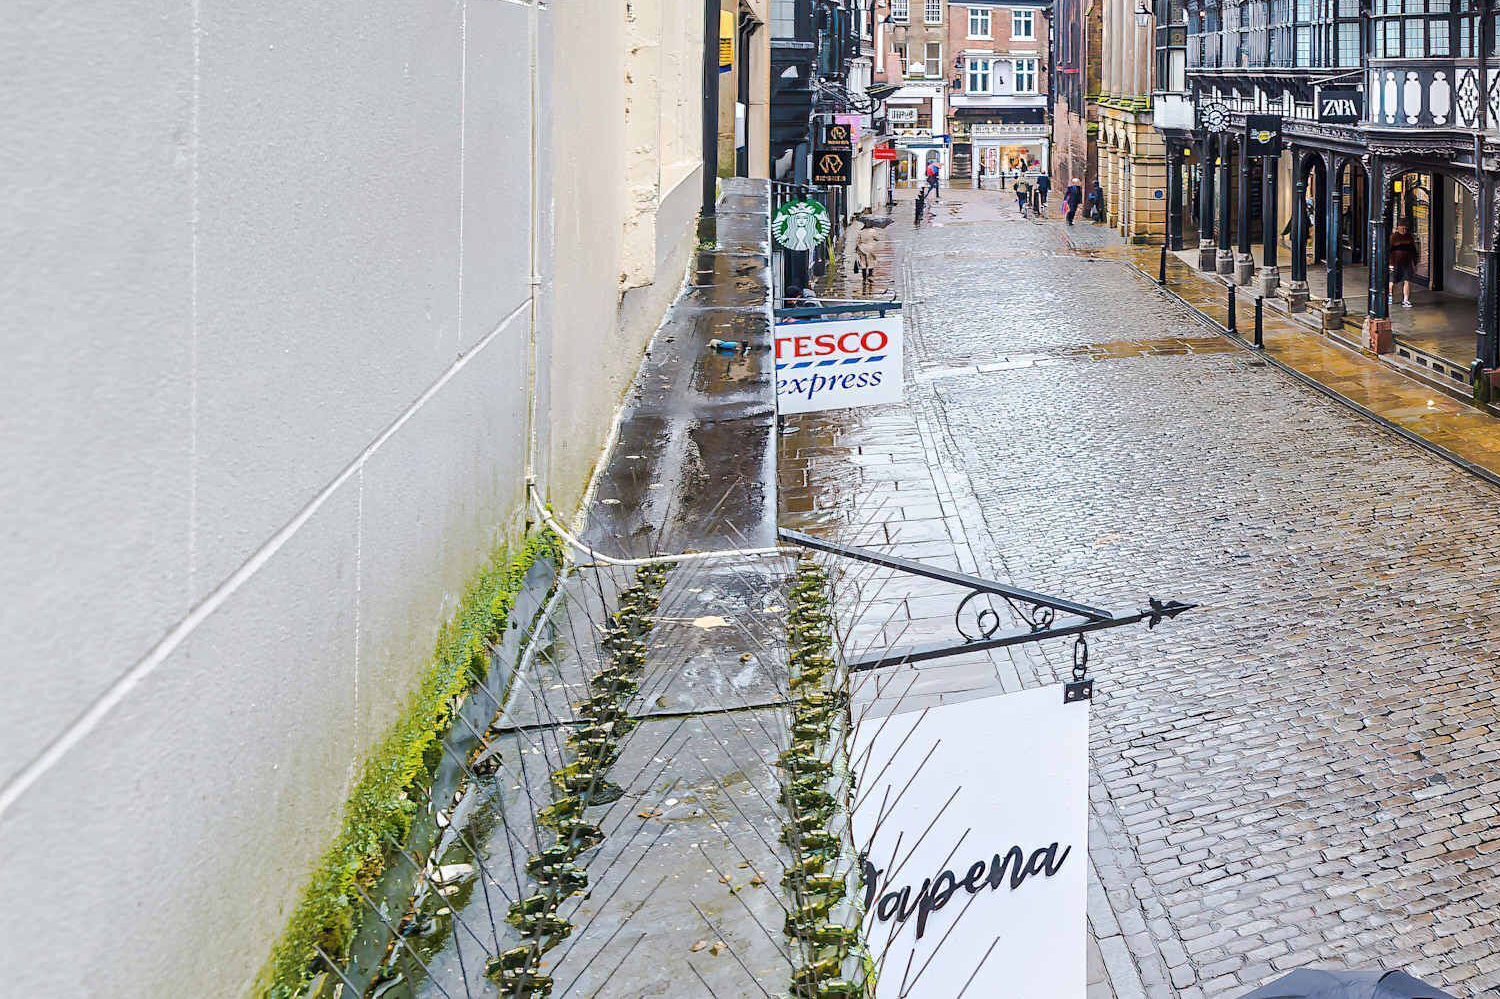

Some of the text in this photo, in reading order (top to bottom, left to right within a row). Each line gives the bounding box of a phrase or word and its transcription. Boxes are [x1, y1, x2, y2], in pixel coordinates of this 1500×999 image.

[1322, 99, 1357, 116] ZARA
[775, 330, 888, 359] TESCO
[776, 370, 883, 400] express
